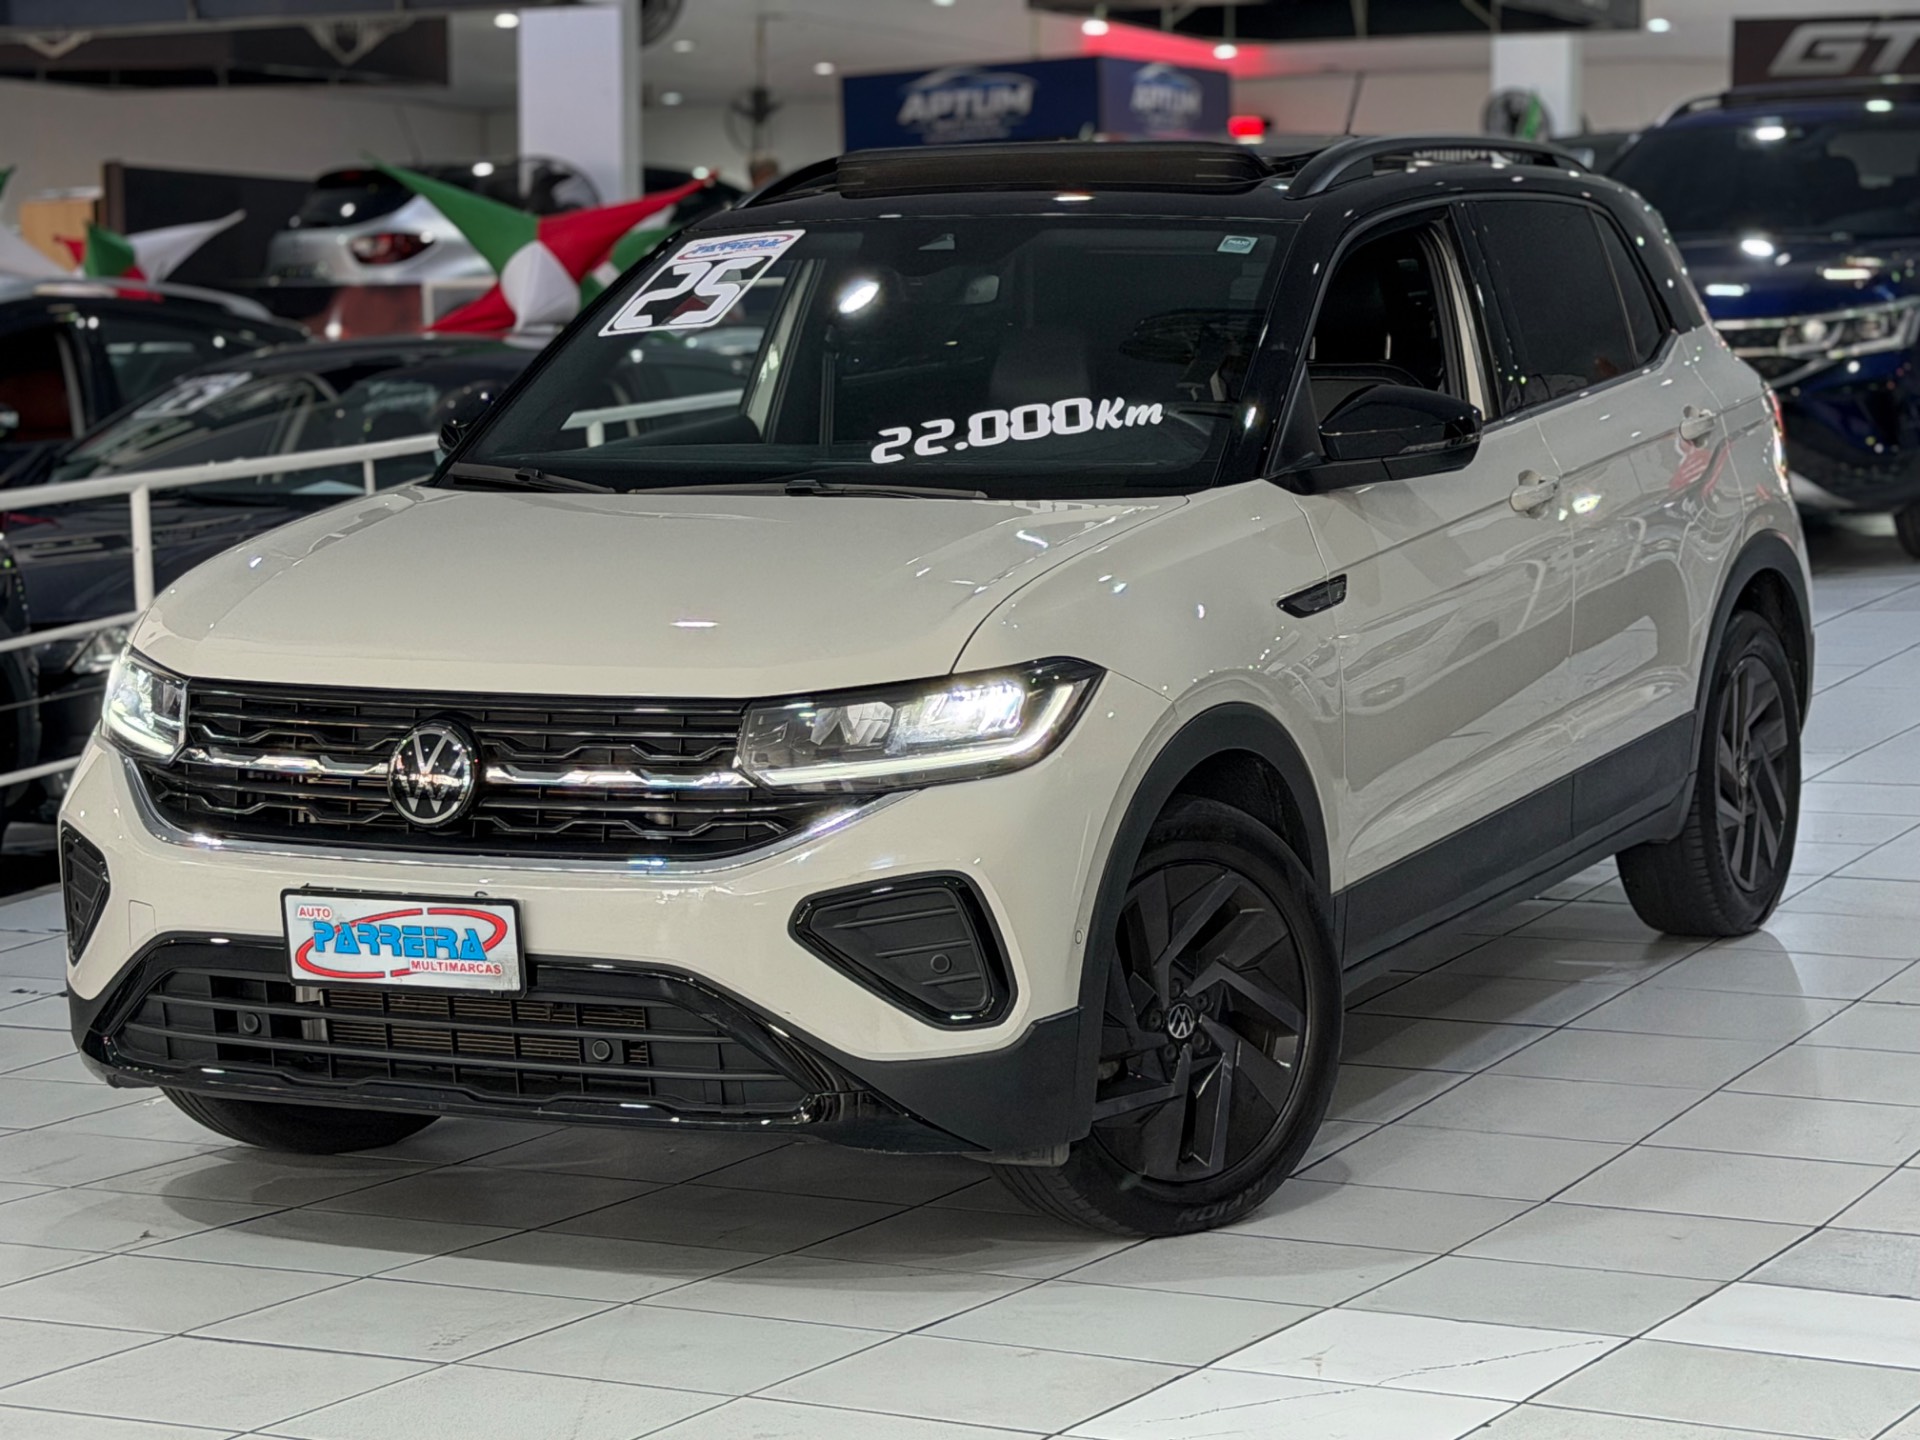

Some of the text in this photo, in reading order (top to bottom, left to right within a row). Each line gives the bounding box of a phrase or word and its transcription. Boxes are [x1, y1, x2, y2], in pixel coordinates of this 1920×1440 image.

[897, 81, 1035, 125] APTUM
[613, 255, 766, 330] 25
[299, 906, 331, 918] AUTO
[313, 921, 487, 961] PARREIRA
[410, 959, 502, 974] MULTIMARCAS
